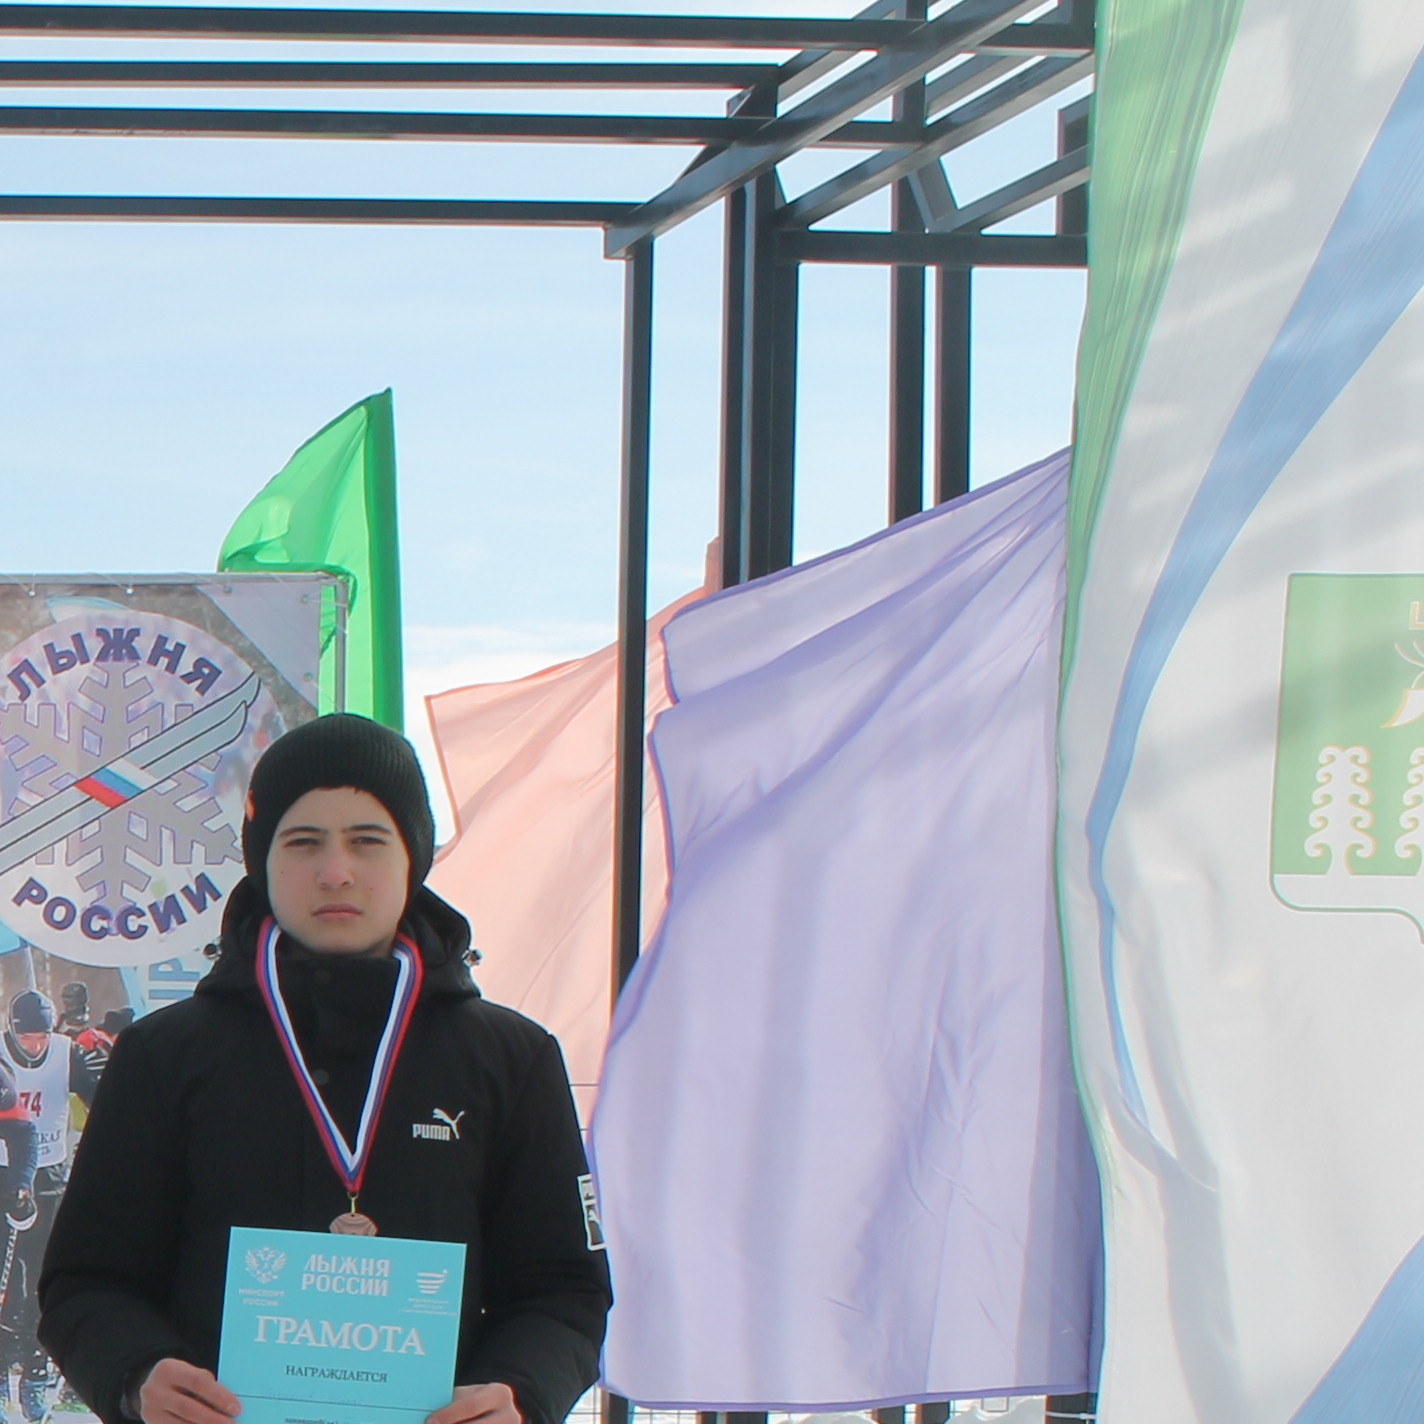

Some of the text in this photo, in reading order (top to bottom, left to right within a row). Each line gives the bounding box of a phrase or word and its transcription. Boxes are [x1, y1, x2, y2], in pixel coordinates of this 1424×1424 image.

[7, 627, 223, 702] ЛЫЖНЯ
[11, 872, 223, 940] РОССИИ
[413, 1124, 450, 1141] PUMA
[304, 1254, 391, 1277] ЛЫЖНЯ
[302, 1274, 390, 1297] РОССИИ
[254, 1315, 426, 1355] ГРАМОТА
[286, 1365, 388, 1383] НАГРАЖДАЕТСЯ
